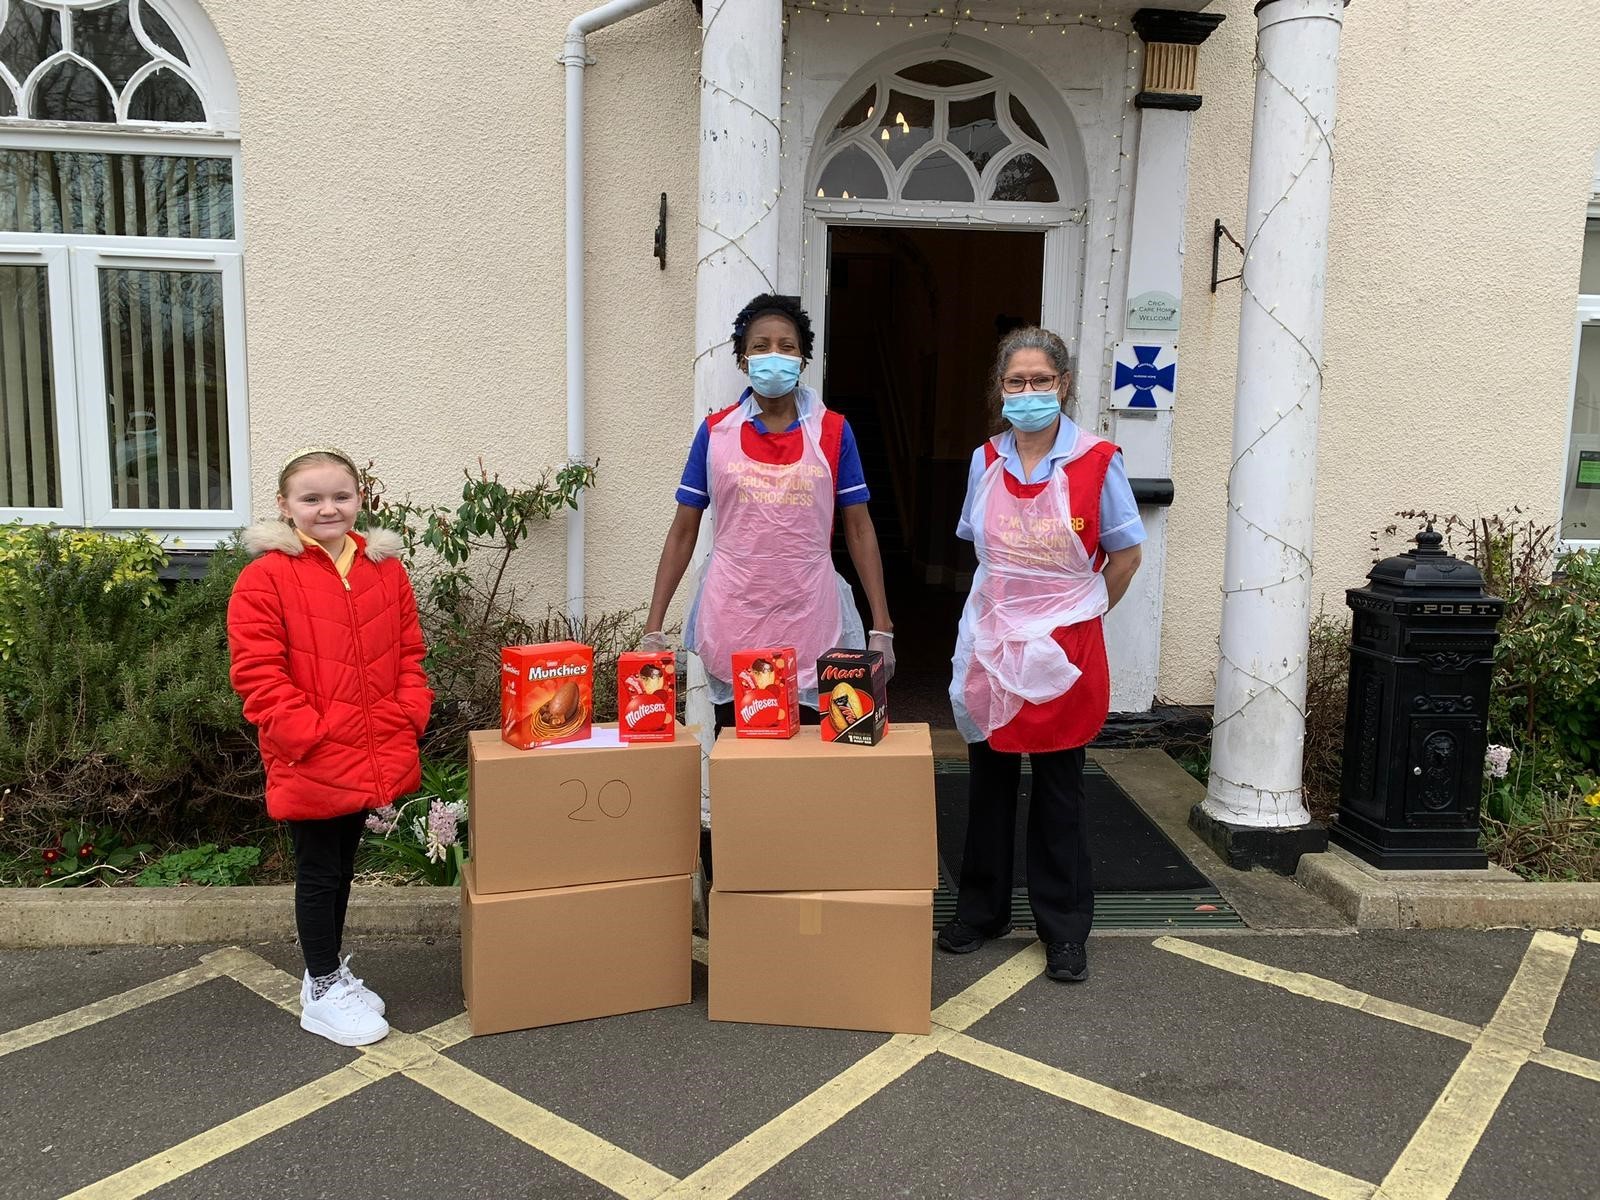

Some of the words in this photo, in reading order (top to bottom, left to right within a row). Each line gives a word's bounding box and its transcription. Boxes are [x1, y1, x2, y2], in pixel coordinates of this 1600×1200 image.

[727, 462, 745, 473] DO
[738, 476, 770, 489] DRUG
[751, 491, 813, 507] PROGRESS
[1029, 517, 1085, 531] DISTRB
[1423, 604, 1491, 615] POST
[528, 663, 588, 681] Munchies
[820, 665, 865, 681] Mars
[625, 703, 666, 728] Maltesers
[740, 698, 779, 724] Maltesers
[559, 778, 632, 822] 20
